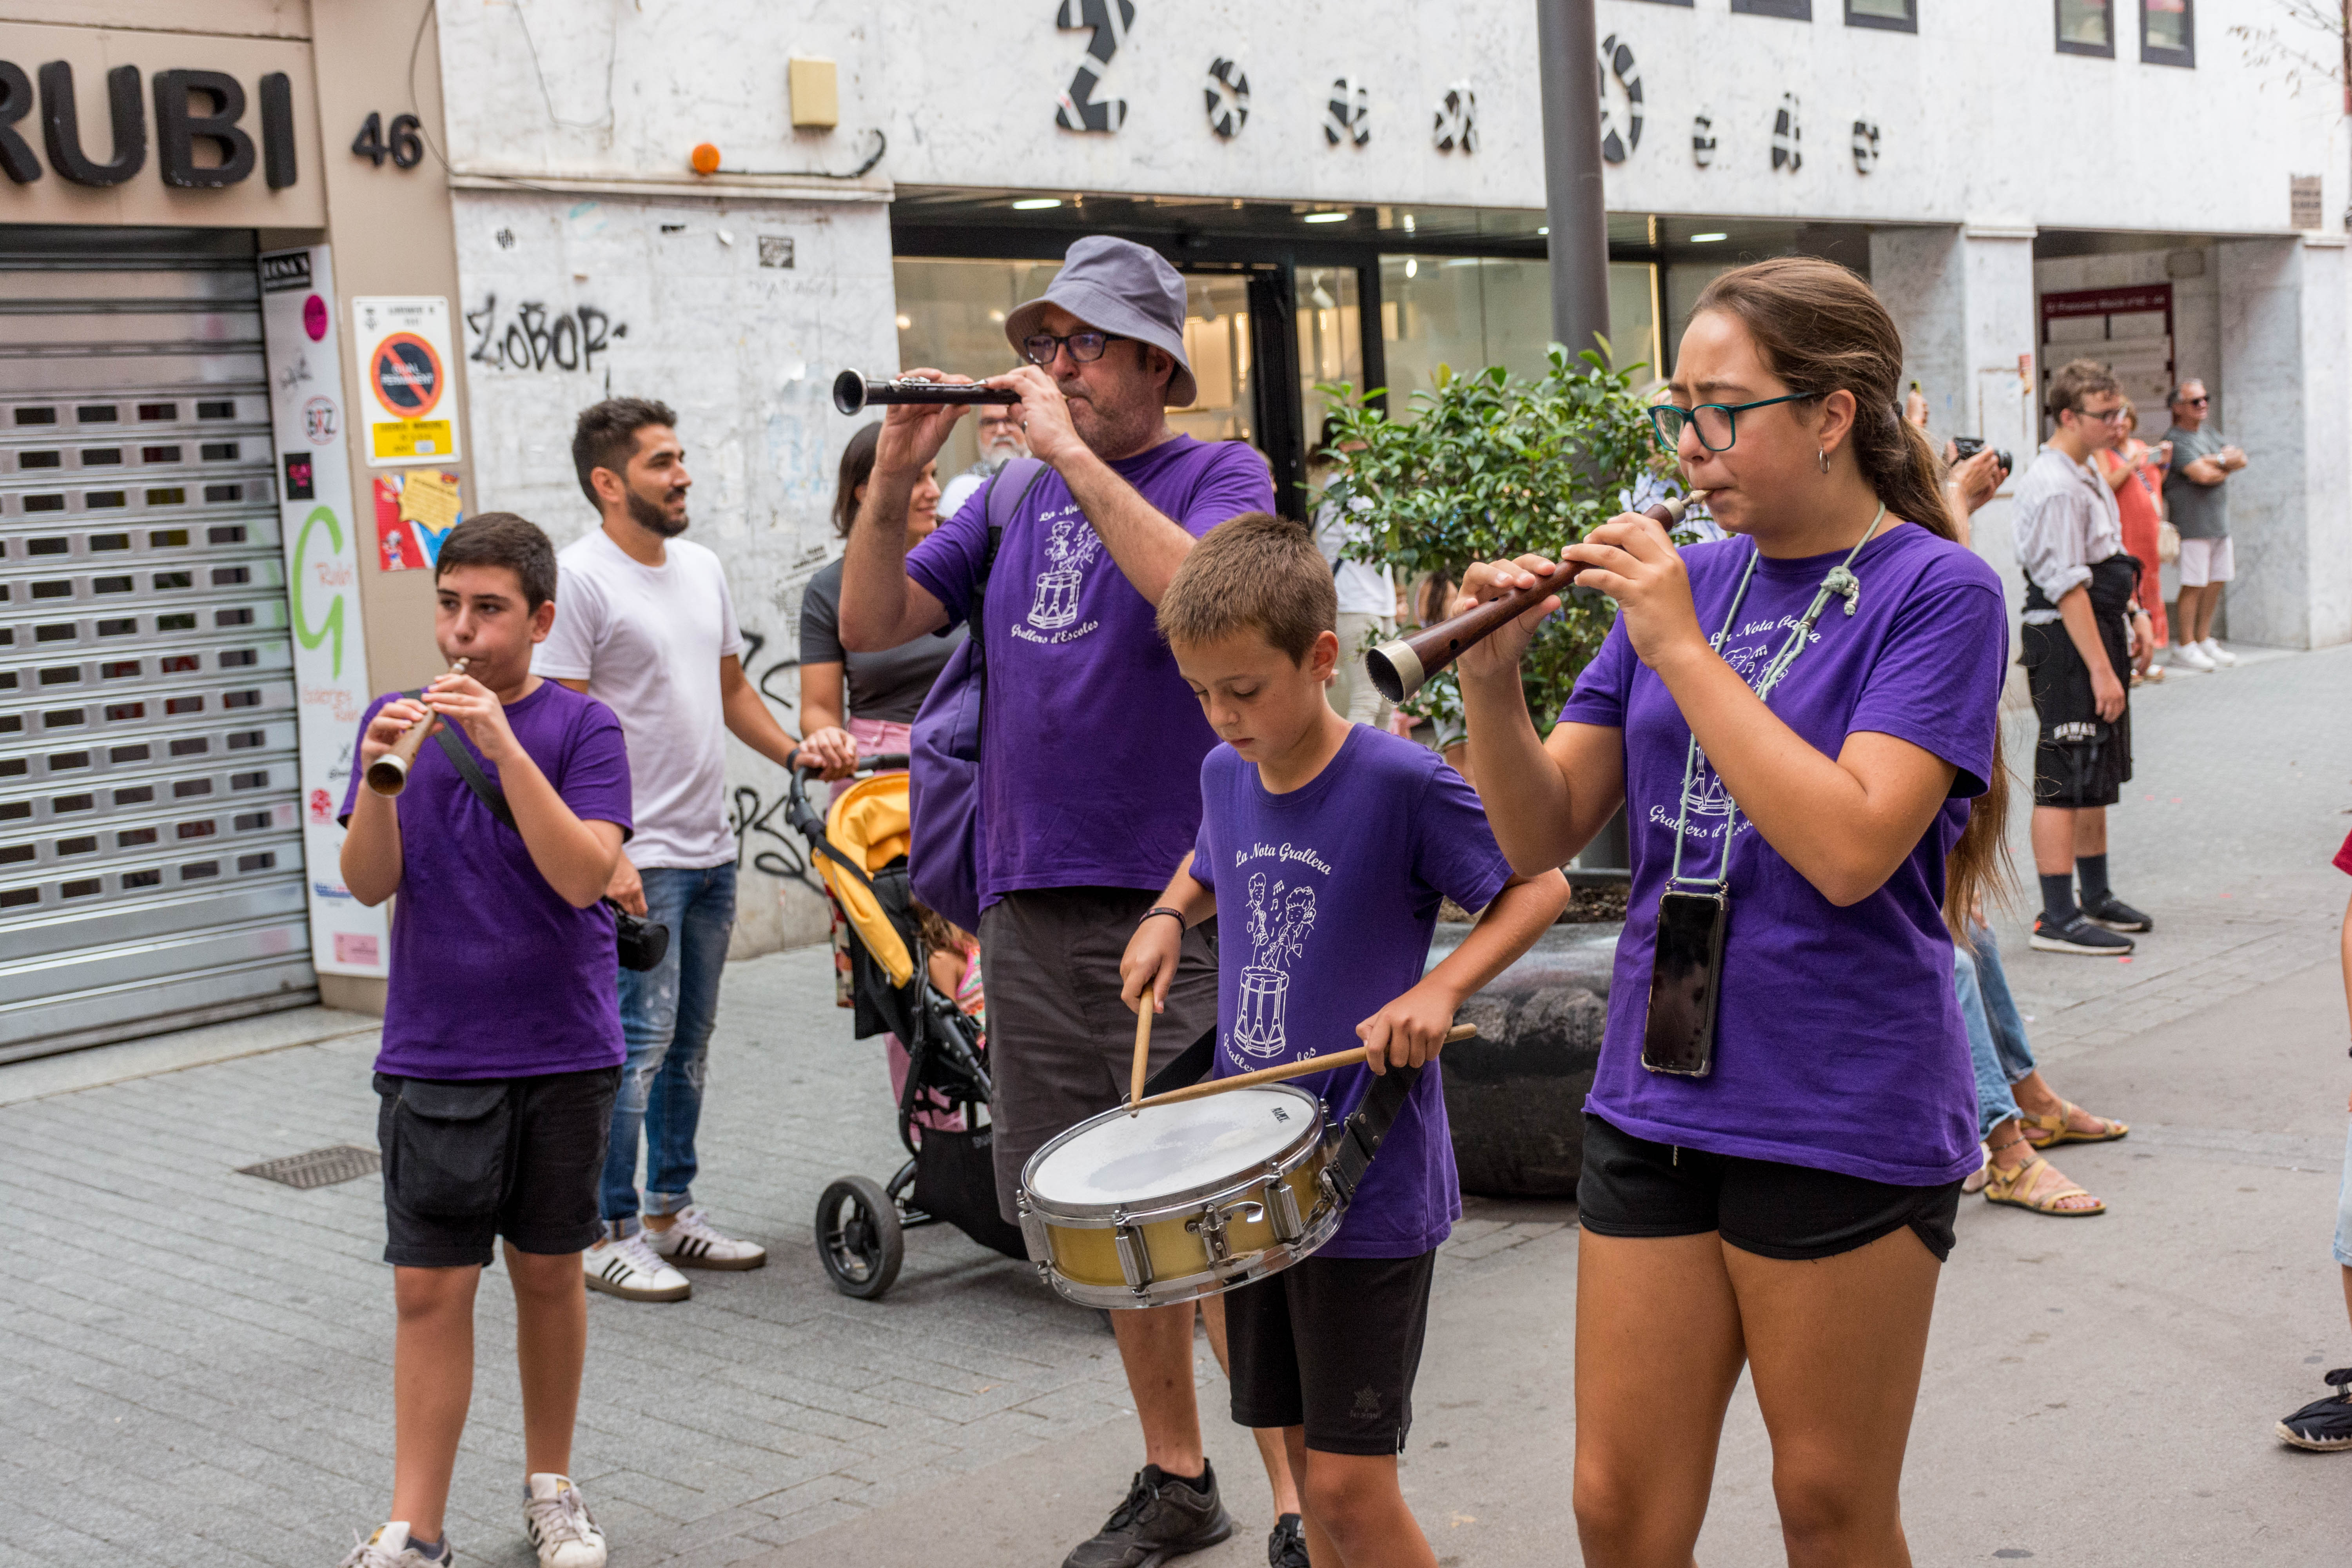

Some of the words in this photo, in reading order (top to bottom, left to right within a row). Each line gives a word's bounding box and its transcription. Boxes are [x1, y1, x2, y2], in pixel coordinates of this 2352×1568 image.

[352, 111, 424, 169] 46
[1736, 620, 1774, 637] Nota
[1236, 850, 1248, 868] La
[1250, 842, 1276, 859] Nota
[1279, 842, 1331, 875] Grallera
